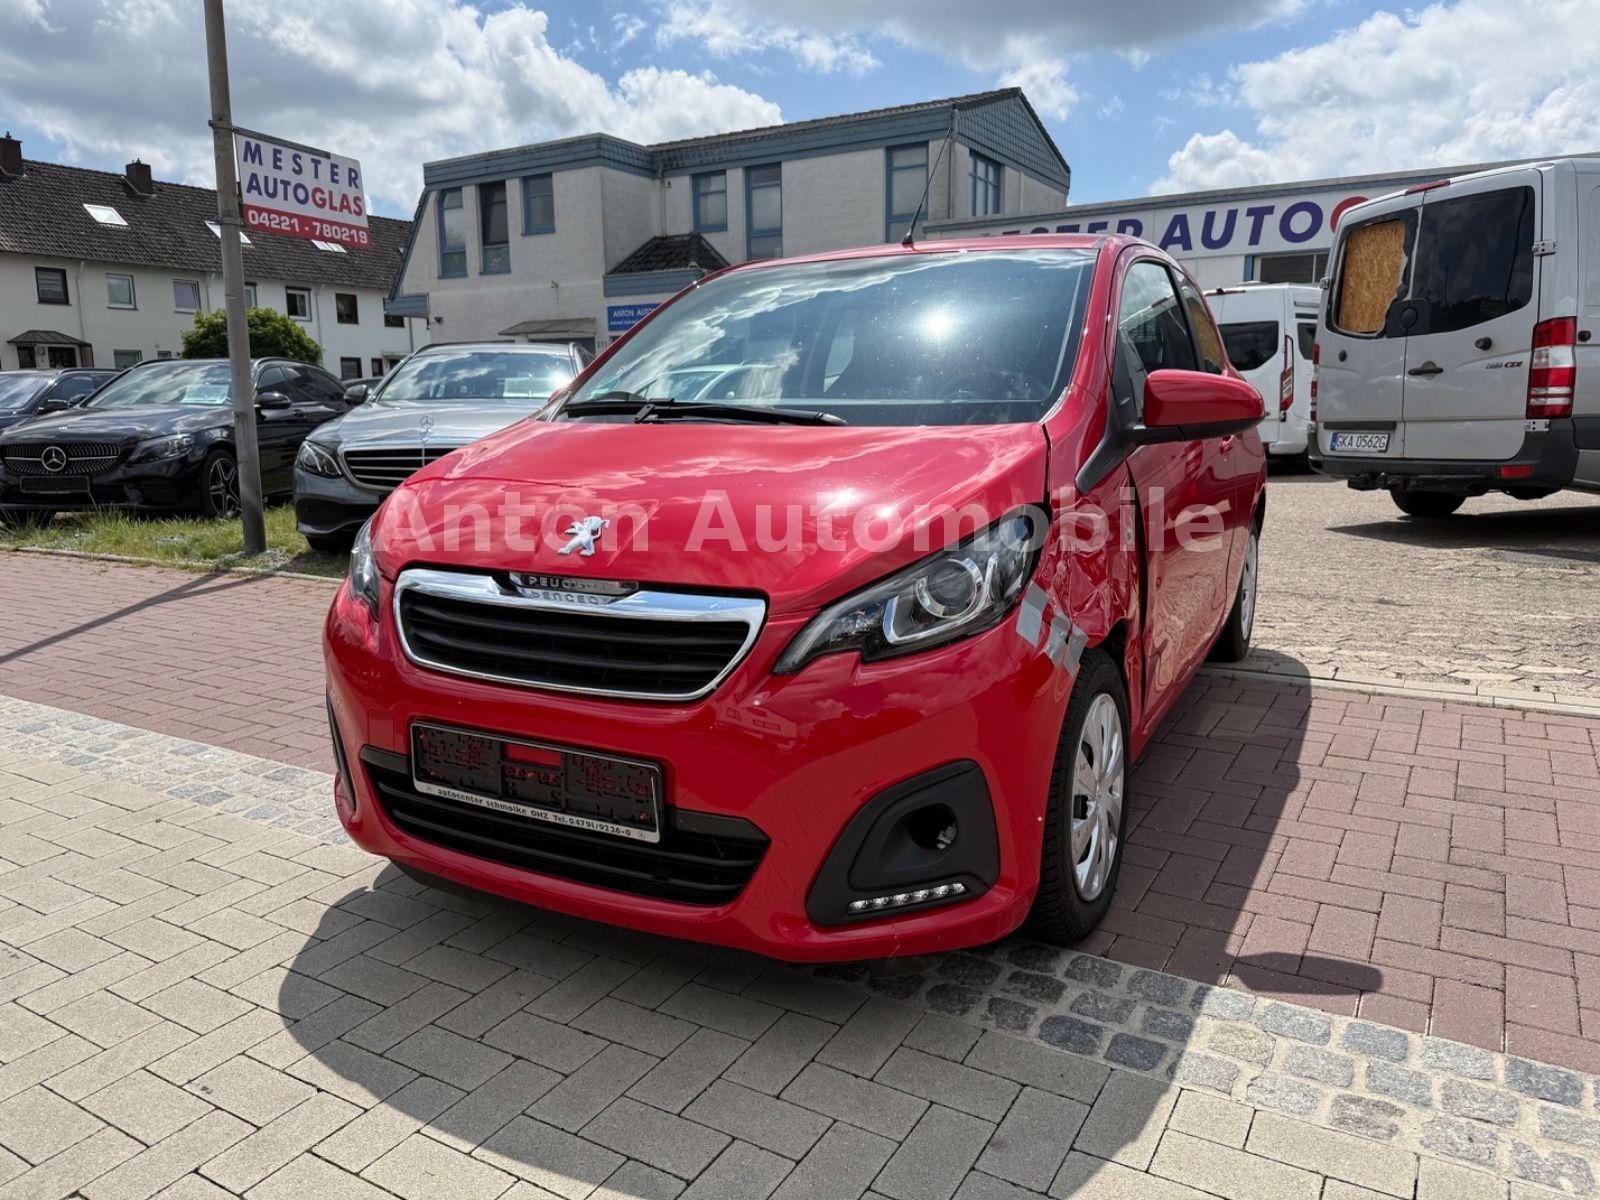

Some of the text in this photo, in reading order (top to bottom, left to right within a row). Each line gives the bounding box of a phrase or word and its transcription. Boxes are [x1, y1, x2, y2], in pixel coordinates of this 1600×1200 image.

[243, 140, 359, 189] MESTER
[246, 172, 363, 217] AUTOGLAS
[248, 210, 299, 232] 04221
[312, 221, 367, 244] 780219
[1337, 434, 1353, 448] GKA
